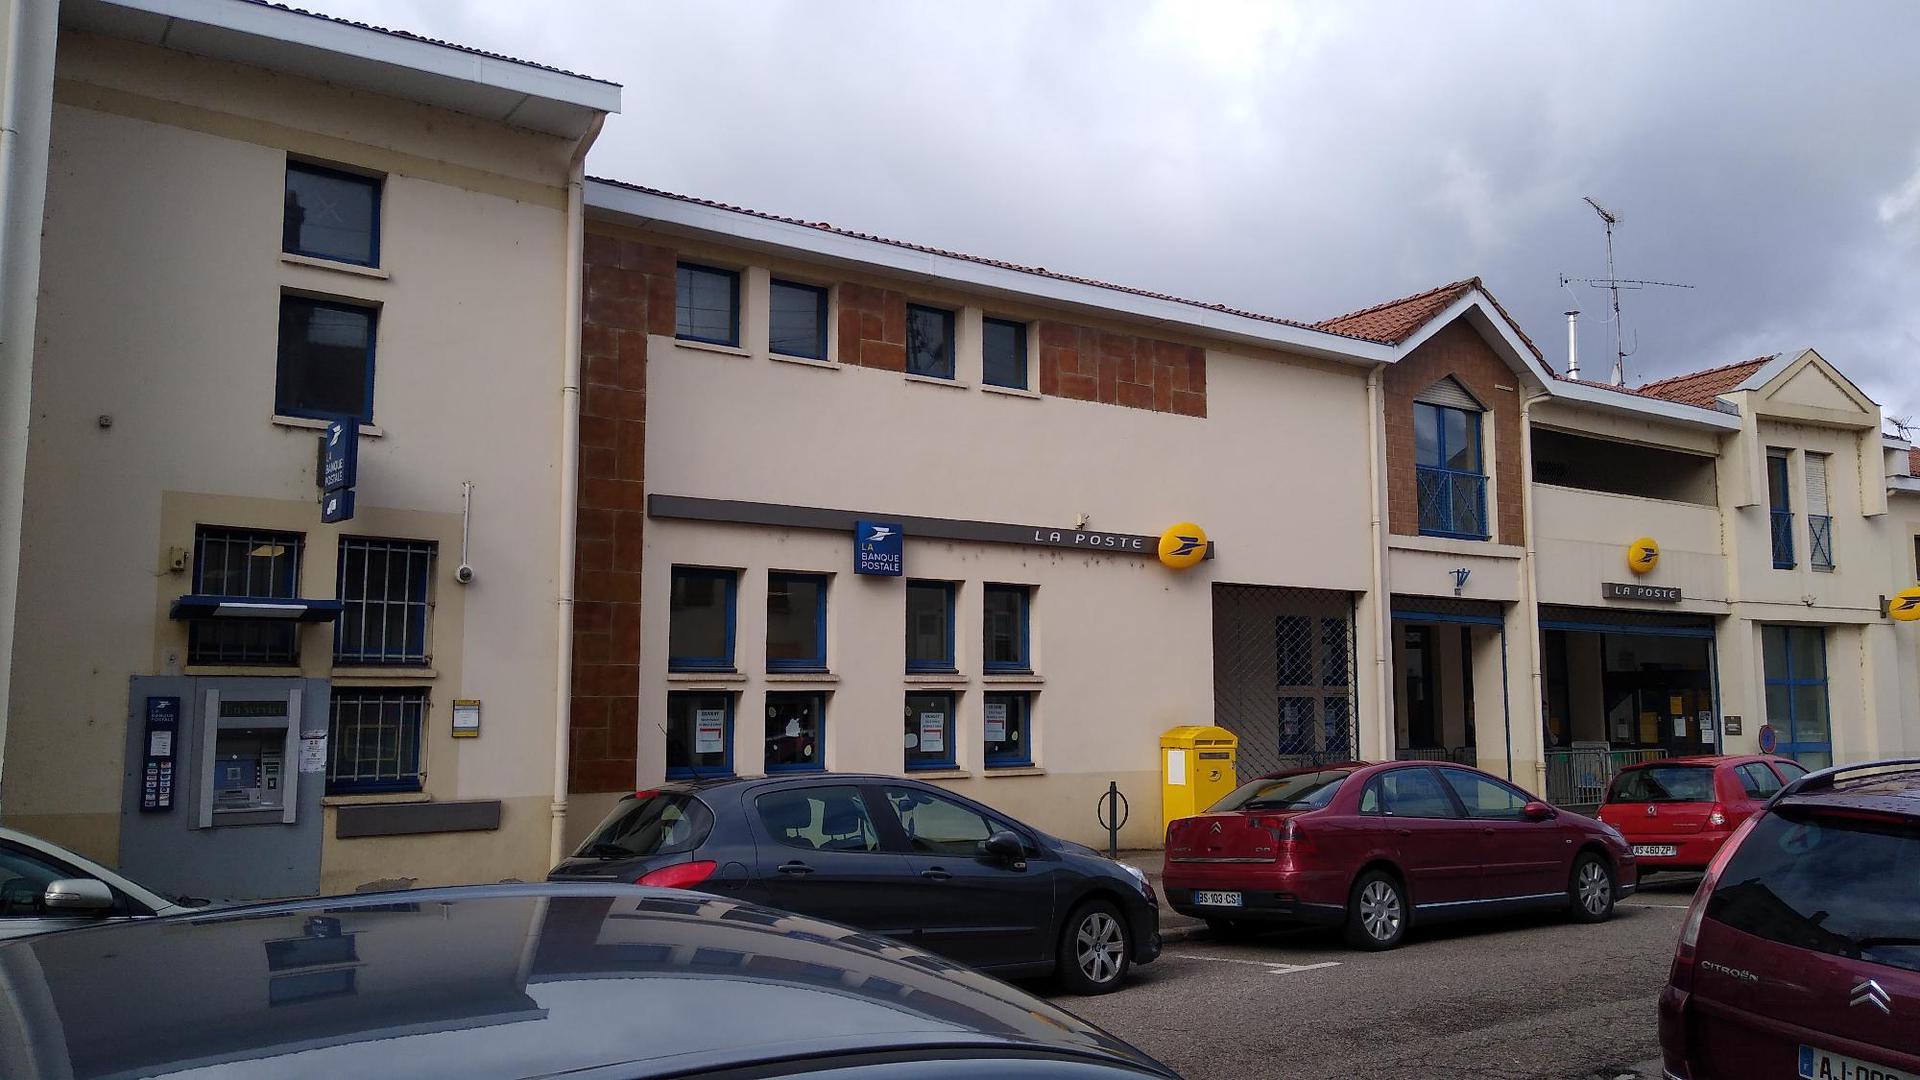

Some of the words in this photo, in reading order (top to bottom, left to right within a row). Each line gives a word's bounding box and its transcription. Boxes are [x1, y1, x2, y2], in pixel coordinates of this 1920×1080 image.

[1034, 530, 1061, 542] LA
[1075, 533, 1142, 549] POSTE
[861, 543, 874, 551] LA
[861, 552, 900, 563] BANQUE
[861, 561, 900, 572] POSTALE
[1615, 586, 1630, 595] LA
[1637, 587, 1676, 599] POSTE
[1701, 960, 1759, 983] CITROËN
